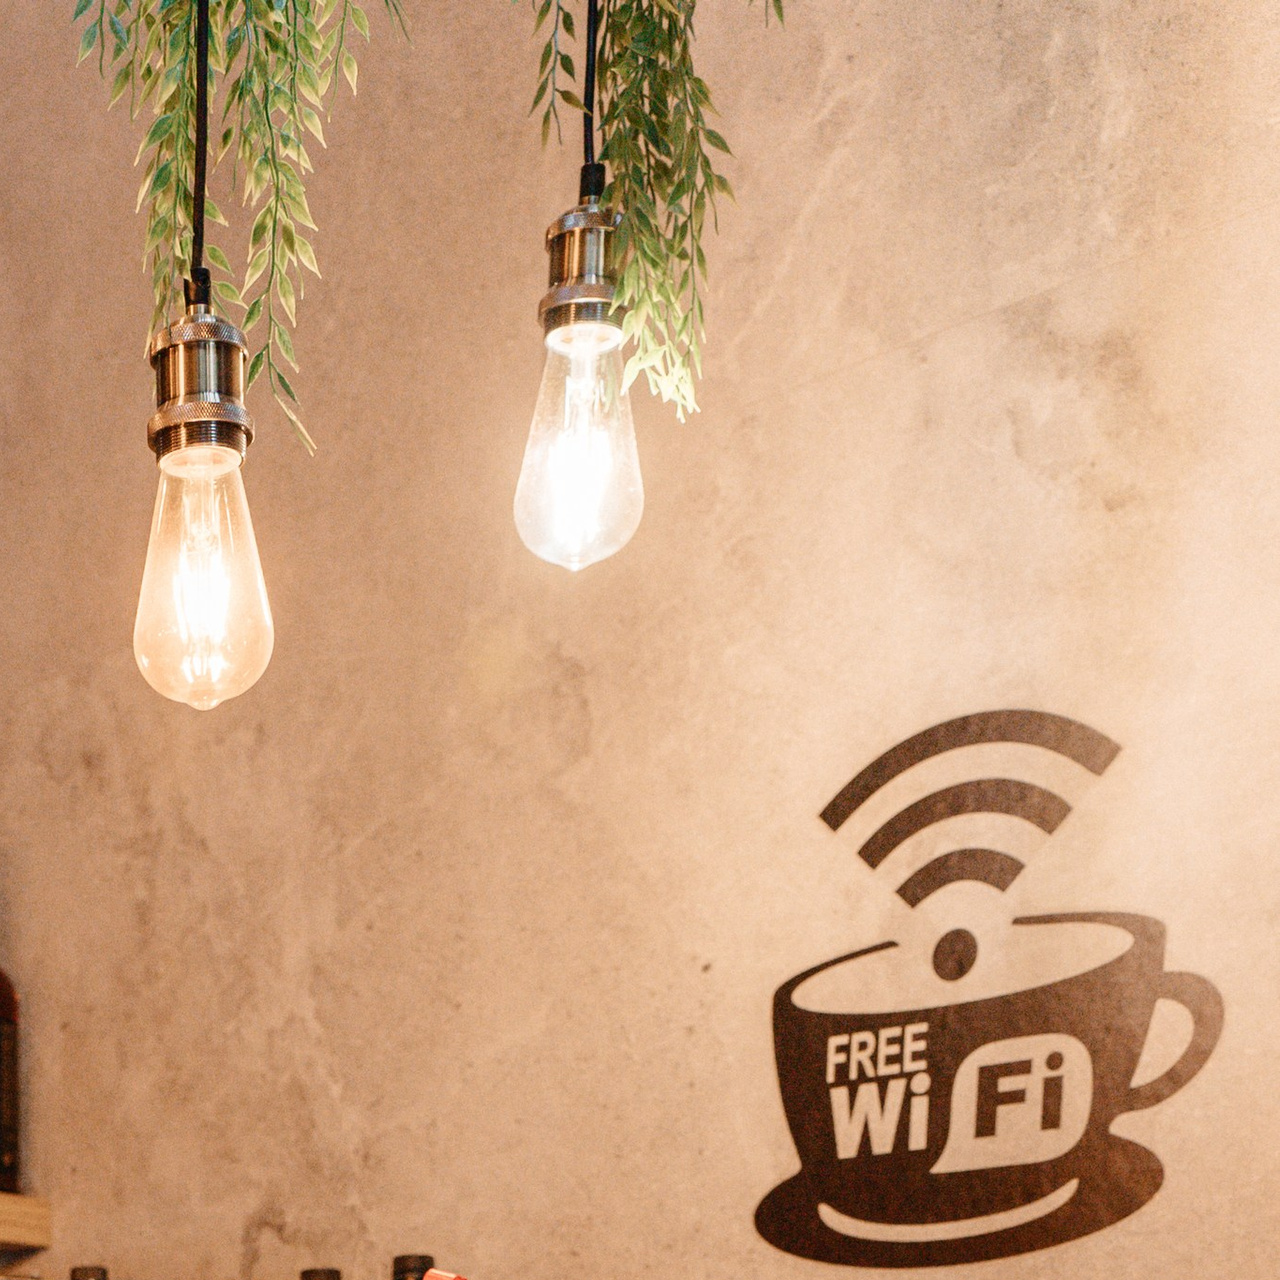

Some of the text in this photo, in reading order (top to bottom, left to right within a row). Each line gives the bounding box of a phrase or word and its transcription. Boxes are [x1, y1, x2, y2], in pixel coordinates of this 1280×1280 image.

[826, 1022, 929, 1084] FREE
[828, 1051, 1065, 1160] Wi Fi
